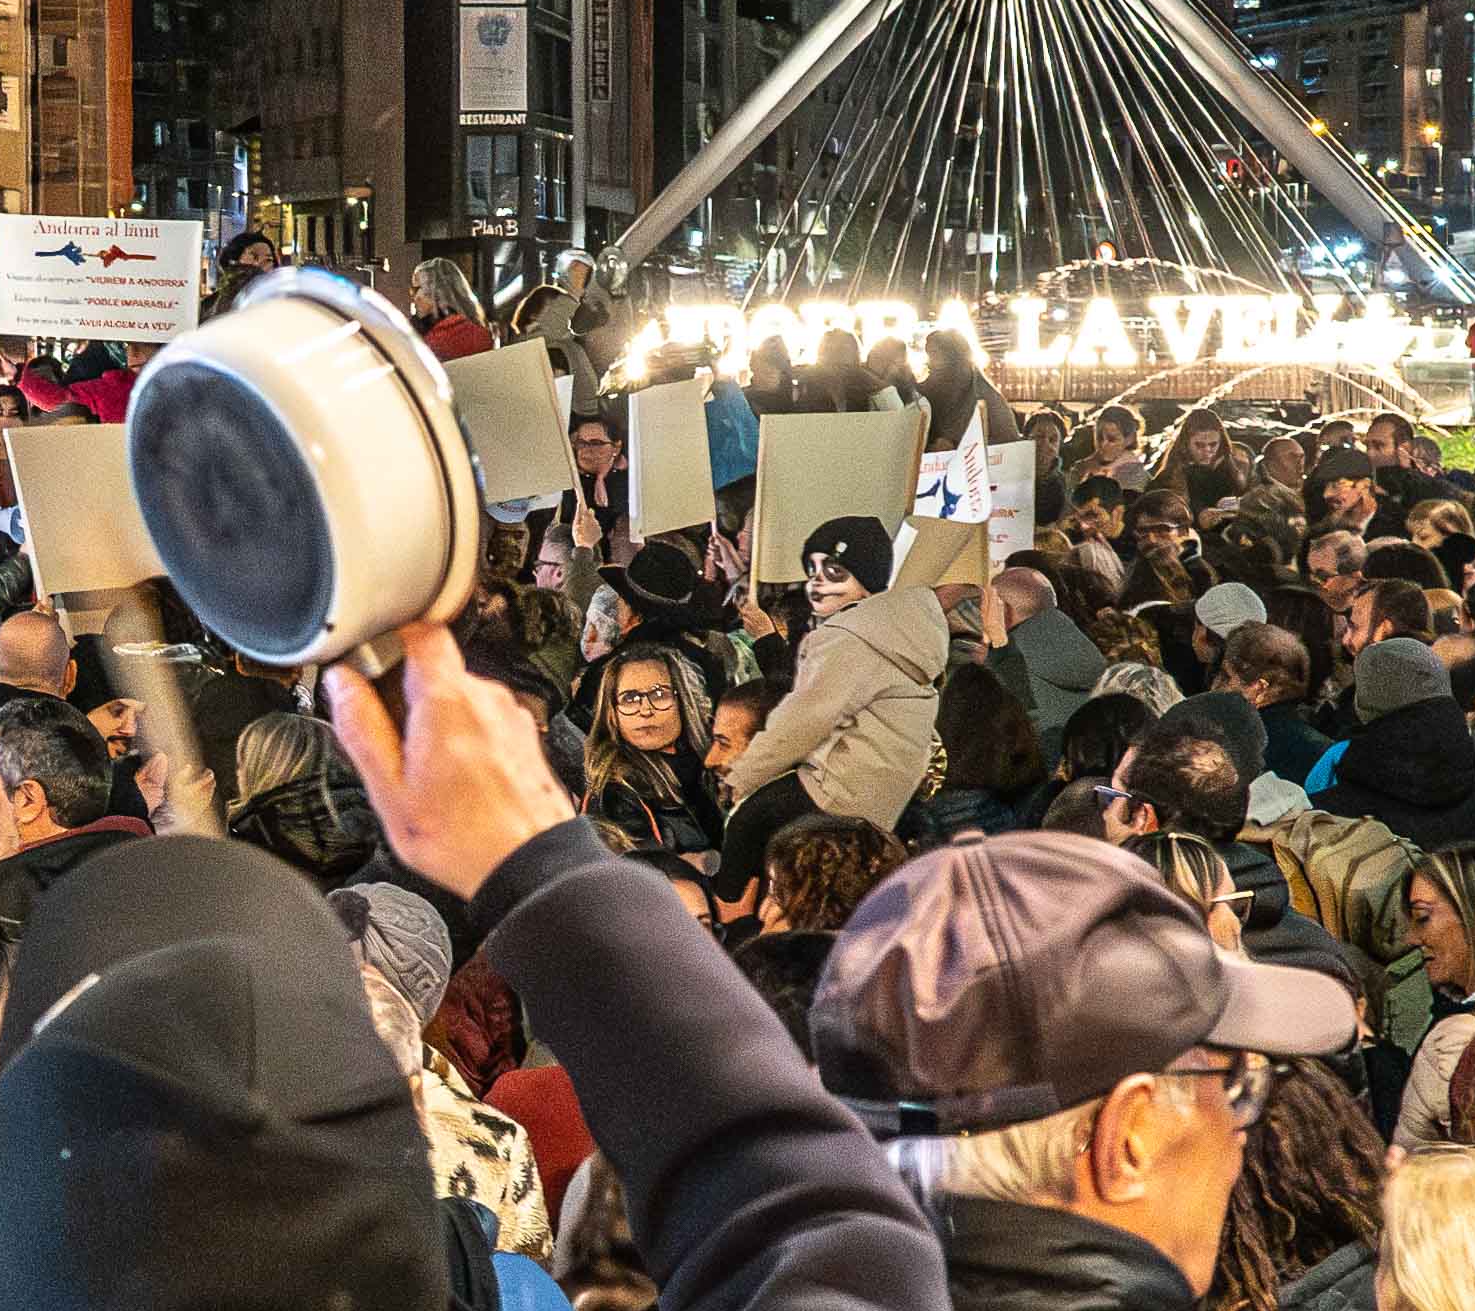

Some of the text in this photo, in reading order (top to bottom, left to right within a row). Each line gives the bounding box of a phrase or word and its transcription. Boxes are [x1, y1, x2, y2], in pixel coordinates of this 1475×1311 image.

[459, 113, 527, 125] RESTAURANT
[33, 219, 99, 237] Andorra
[105, 222, 119, 237] al
[1005, 296, 1137, 366] LA
